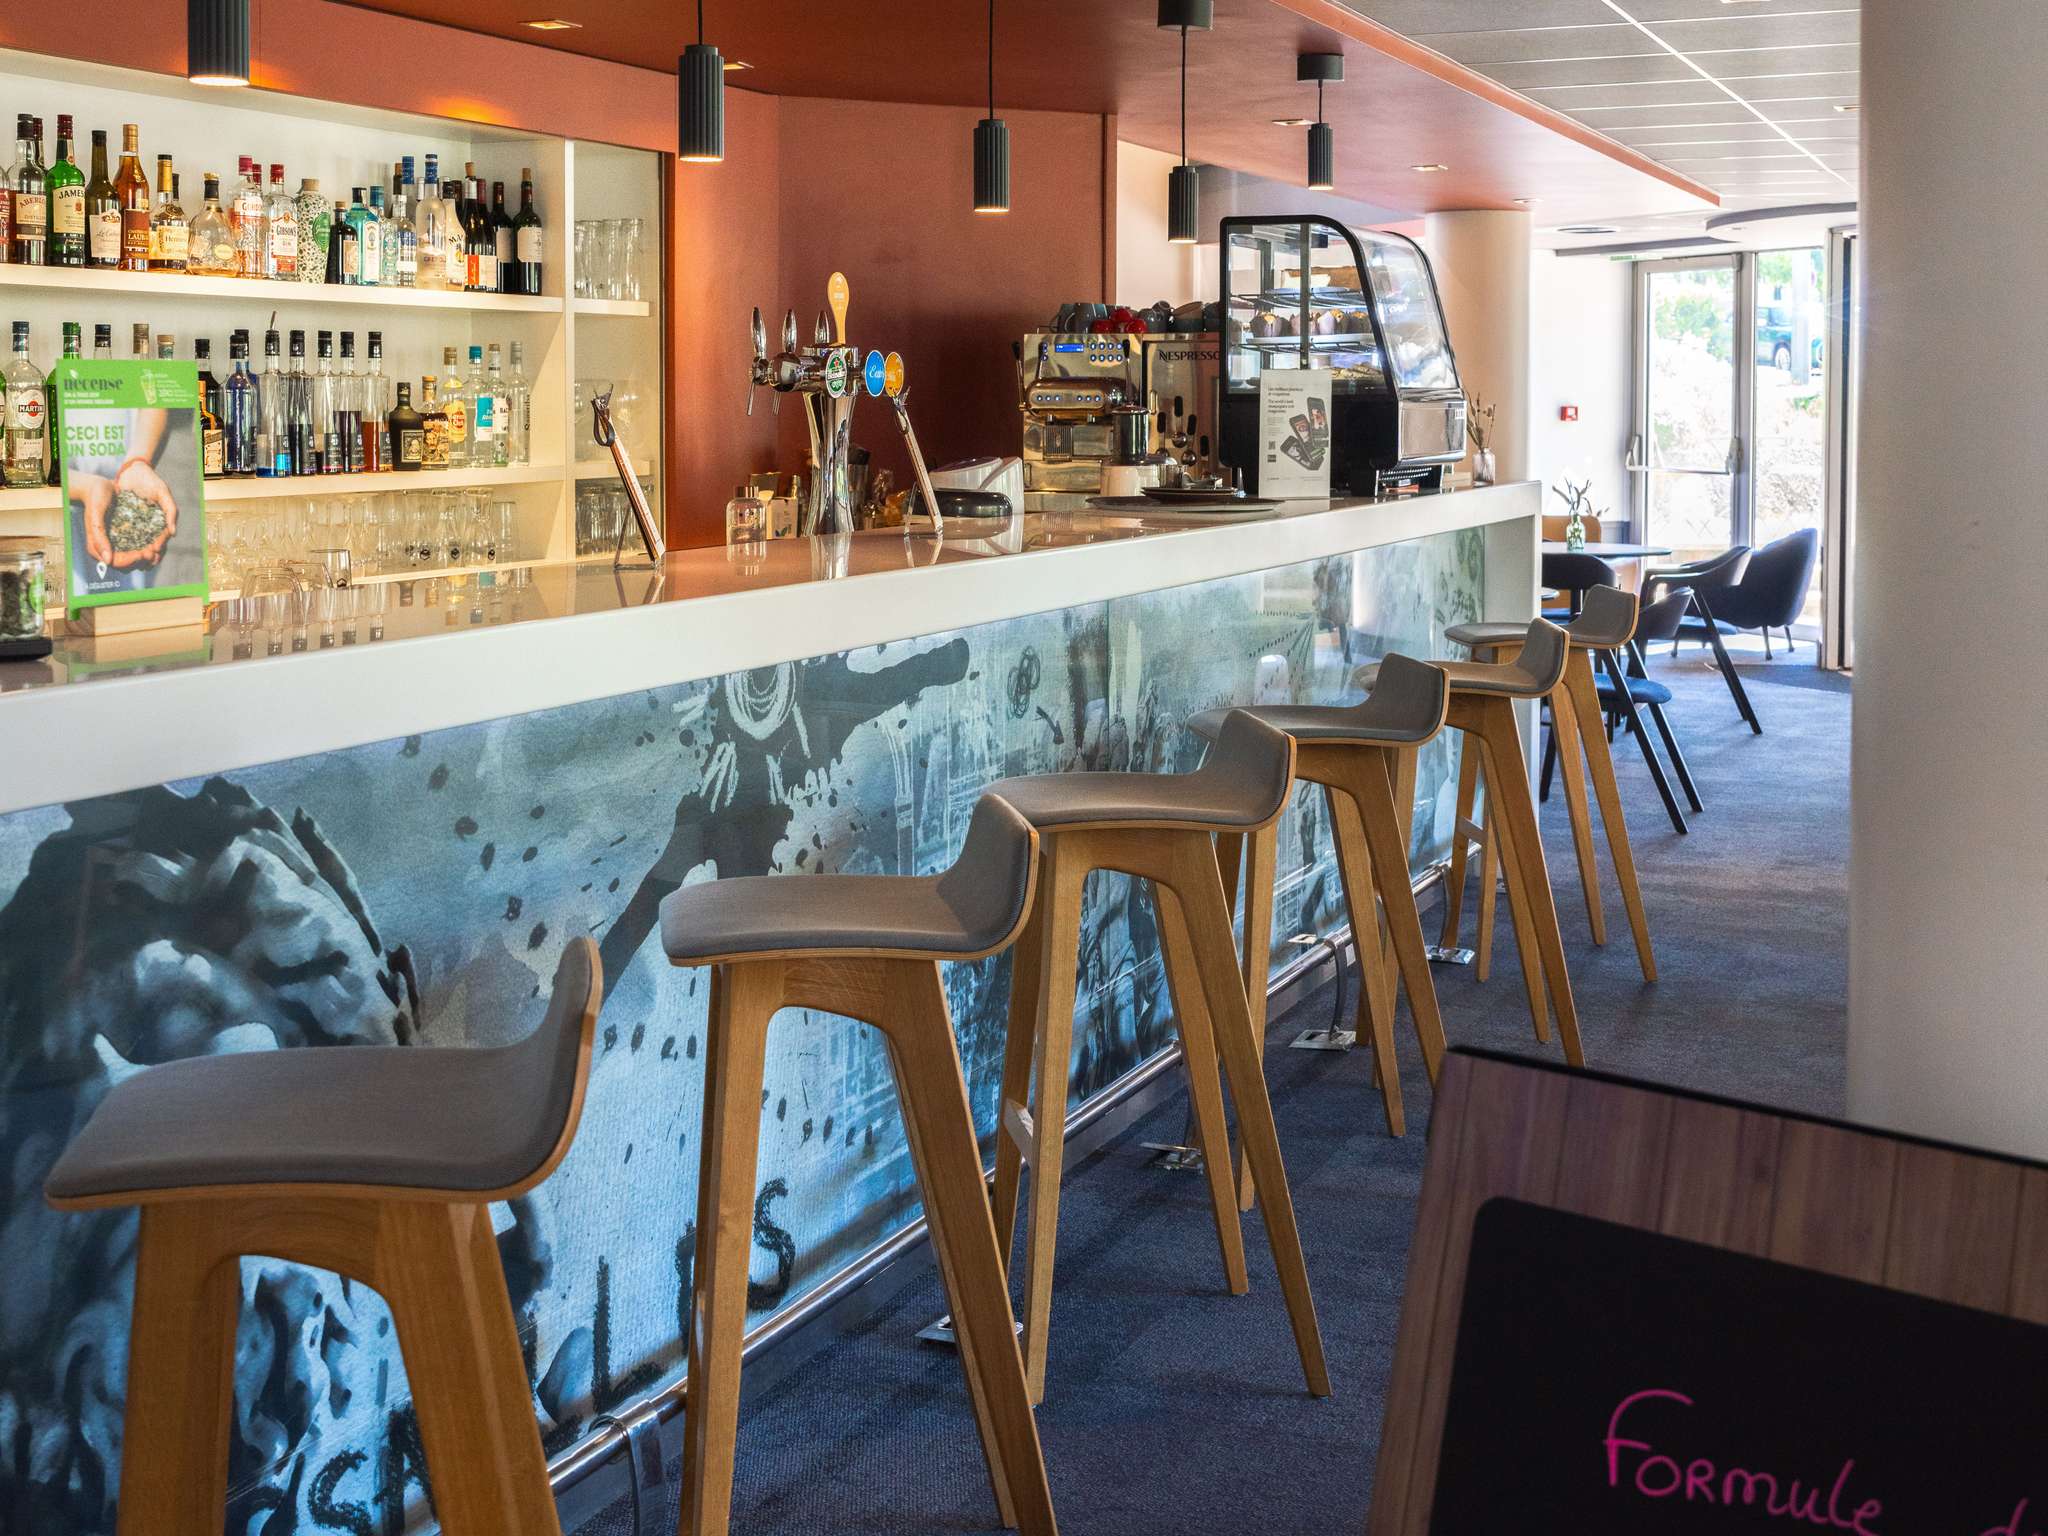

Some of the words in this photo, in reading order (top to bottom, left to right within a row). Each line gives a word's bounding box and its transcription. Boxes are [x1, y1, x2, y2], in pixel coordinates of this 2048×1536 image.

[65, 426, 99, 441] CECI
[104, 425, 125, 441] EST
[88, 441, 126, 457] SODA
